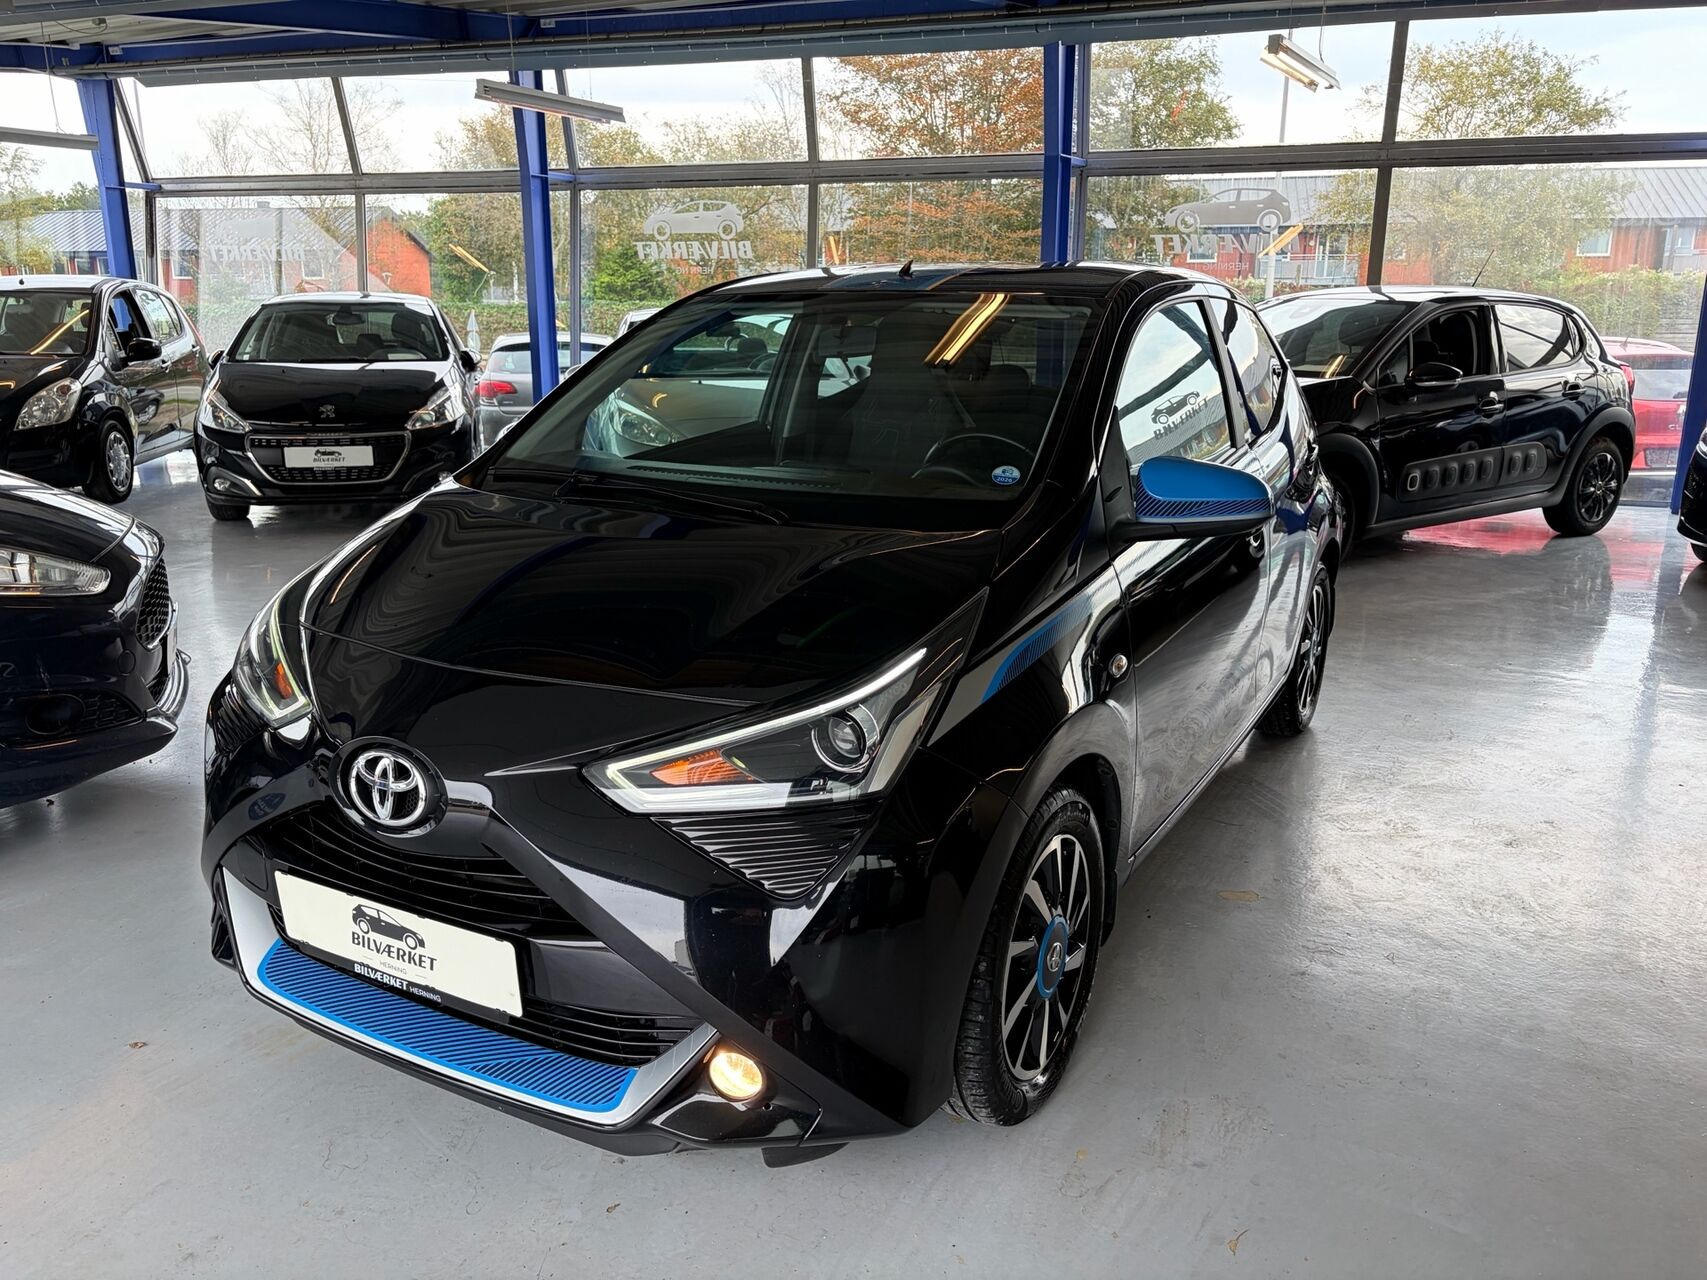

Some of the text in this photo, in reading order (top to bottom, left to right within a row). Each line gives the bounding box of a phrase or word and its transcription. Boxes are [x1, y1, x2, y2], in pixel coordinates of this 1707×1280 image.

[351, 931, 437, 972] BILVÆRKET
[379, 960, 407, 976] HERNING
[354, 963, 442, 1002] BILVÆRKET HERNING
